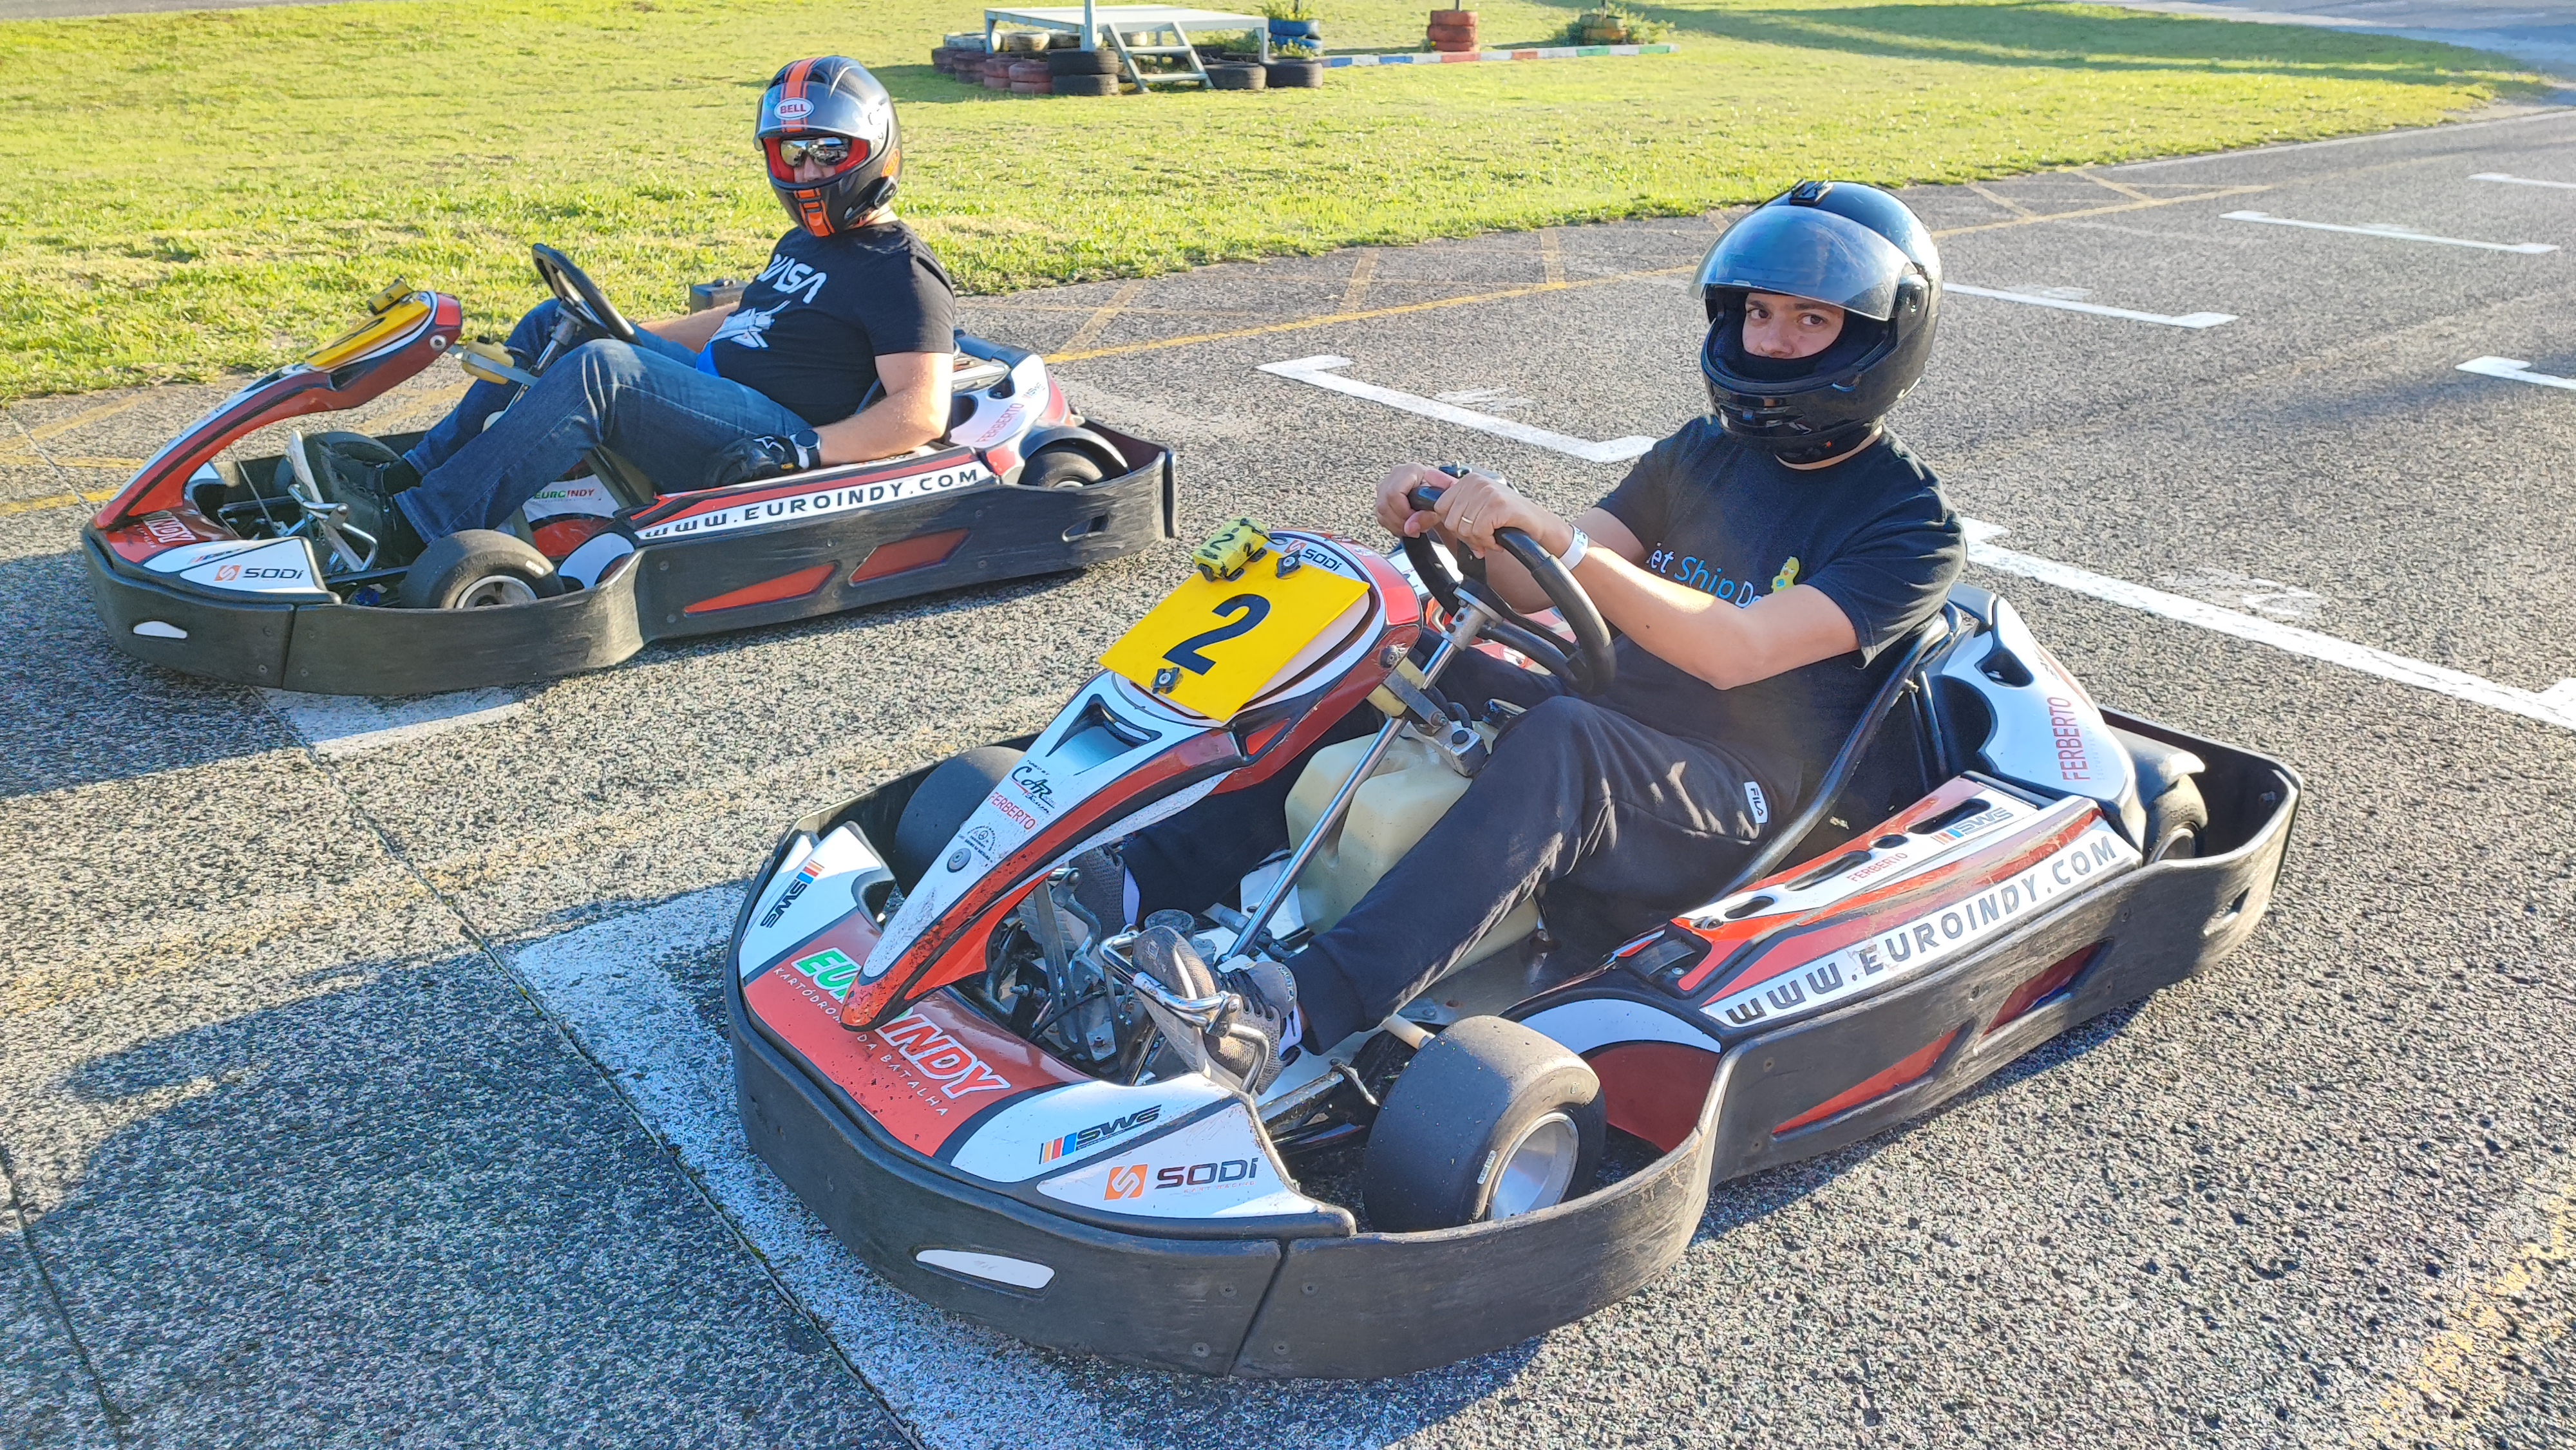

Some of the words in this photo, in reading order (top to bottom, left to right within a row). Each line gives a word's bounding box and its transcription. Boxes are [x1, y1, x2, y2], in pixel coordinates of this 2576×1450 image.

[780, 104, 806, 114] BELL
[757, 253, 827, 304] NASA
[975, 403, 1025, 442] FERBERTO
[1209, 533, 1235, 551] 2
[1244, 542, 1255, 558] 2
[1674, 556, 1735, 599] Ship
[1162, 593, 1271, 675] 2
[2047, 697, 2091, 780] FERBERTO
[987, 791, 1036, 830] FERBERTO
[1750, 788, 1764, 816] FILA
[1954, 807, 2014, 836] SWS
[1847, 852, 1908, 882] FERBERTO
[760, 880, 808, 928] SWS
[1278, 966, 1294, 1002] NAUTICA
[773, 967, 842, 1024] KARTÓDROM
[857, 1034, 877, 1051] DA
[880, 1054, 949, 1116] BATALHA
[1077, 1104, 1162, 1145] SWS
[1216, 1180, 1256, 1190] RACING
